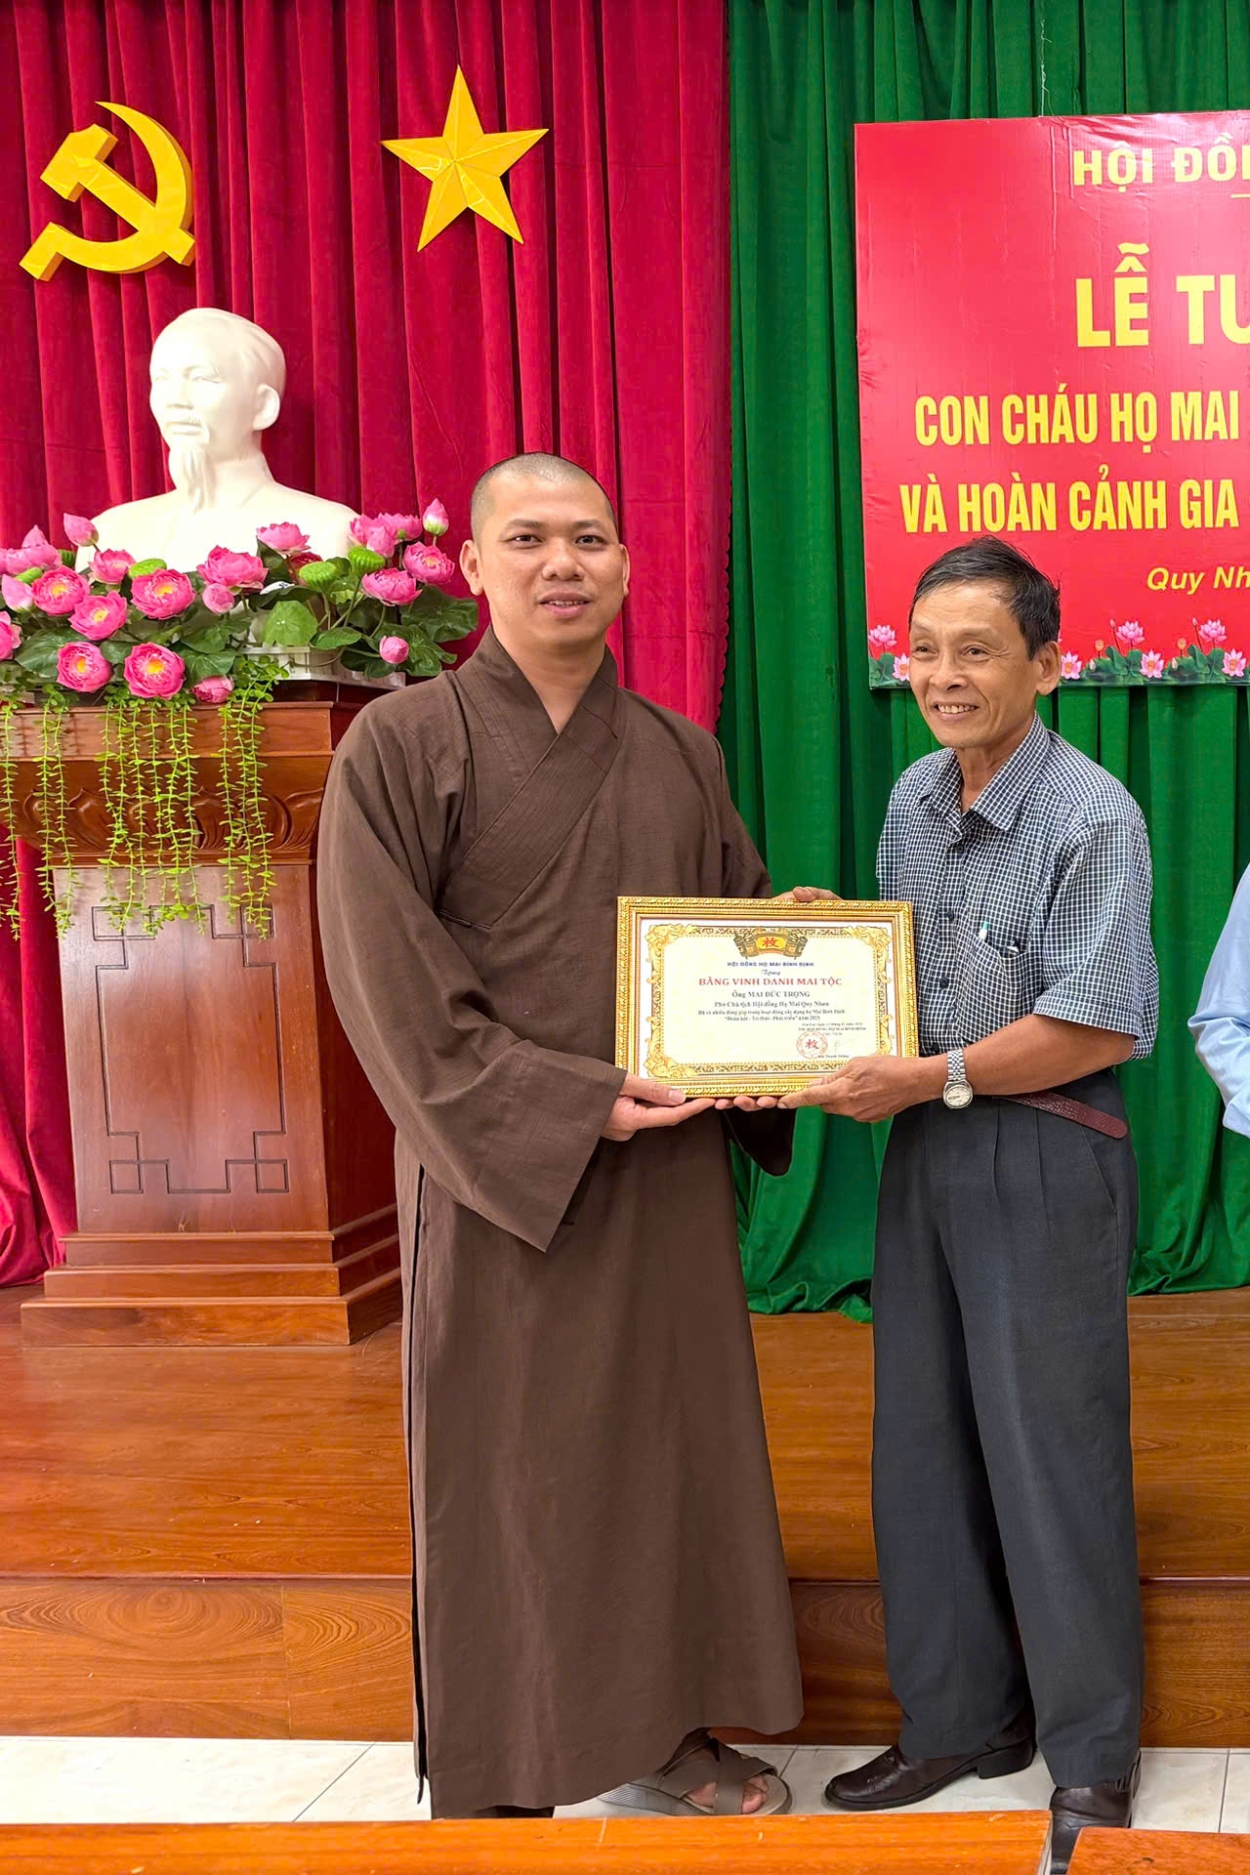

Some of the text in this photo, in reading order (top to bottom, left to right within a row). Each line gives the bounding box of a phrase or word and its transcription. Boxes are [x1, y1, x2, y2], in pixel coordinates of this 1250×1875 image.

[1072, 146, 1154, 194] HỘI
[1075, 242, 1150, 348] LỄ
[914, 395, 990, 448] CON
[1001, 382, 1098, 445] CHÁU
[1110, 392, 1158, 454] HỌ
[1170, 389, 1240, 442] MAI
[899, 472, 948, 533] VÀ
[957, 471, 1057, 533] HOÀN
[1068, 463, 1167, 532] CẢNH
[1179, 478, 1240, 529] GIA
[1147, 567, 1205, 595] Quy
[731, 989, 746, 999] Ông
[765, 989, 782, 998] ĐỨC
[783, 991, 811, 999] TRỌNG
[732, 977, 760, 986] VINH
[763, 977, 794, 986] DANH
[796, 977, 818, 986] MAI
[820, 976, 842, 987] TỘC
